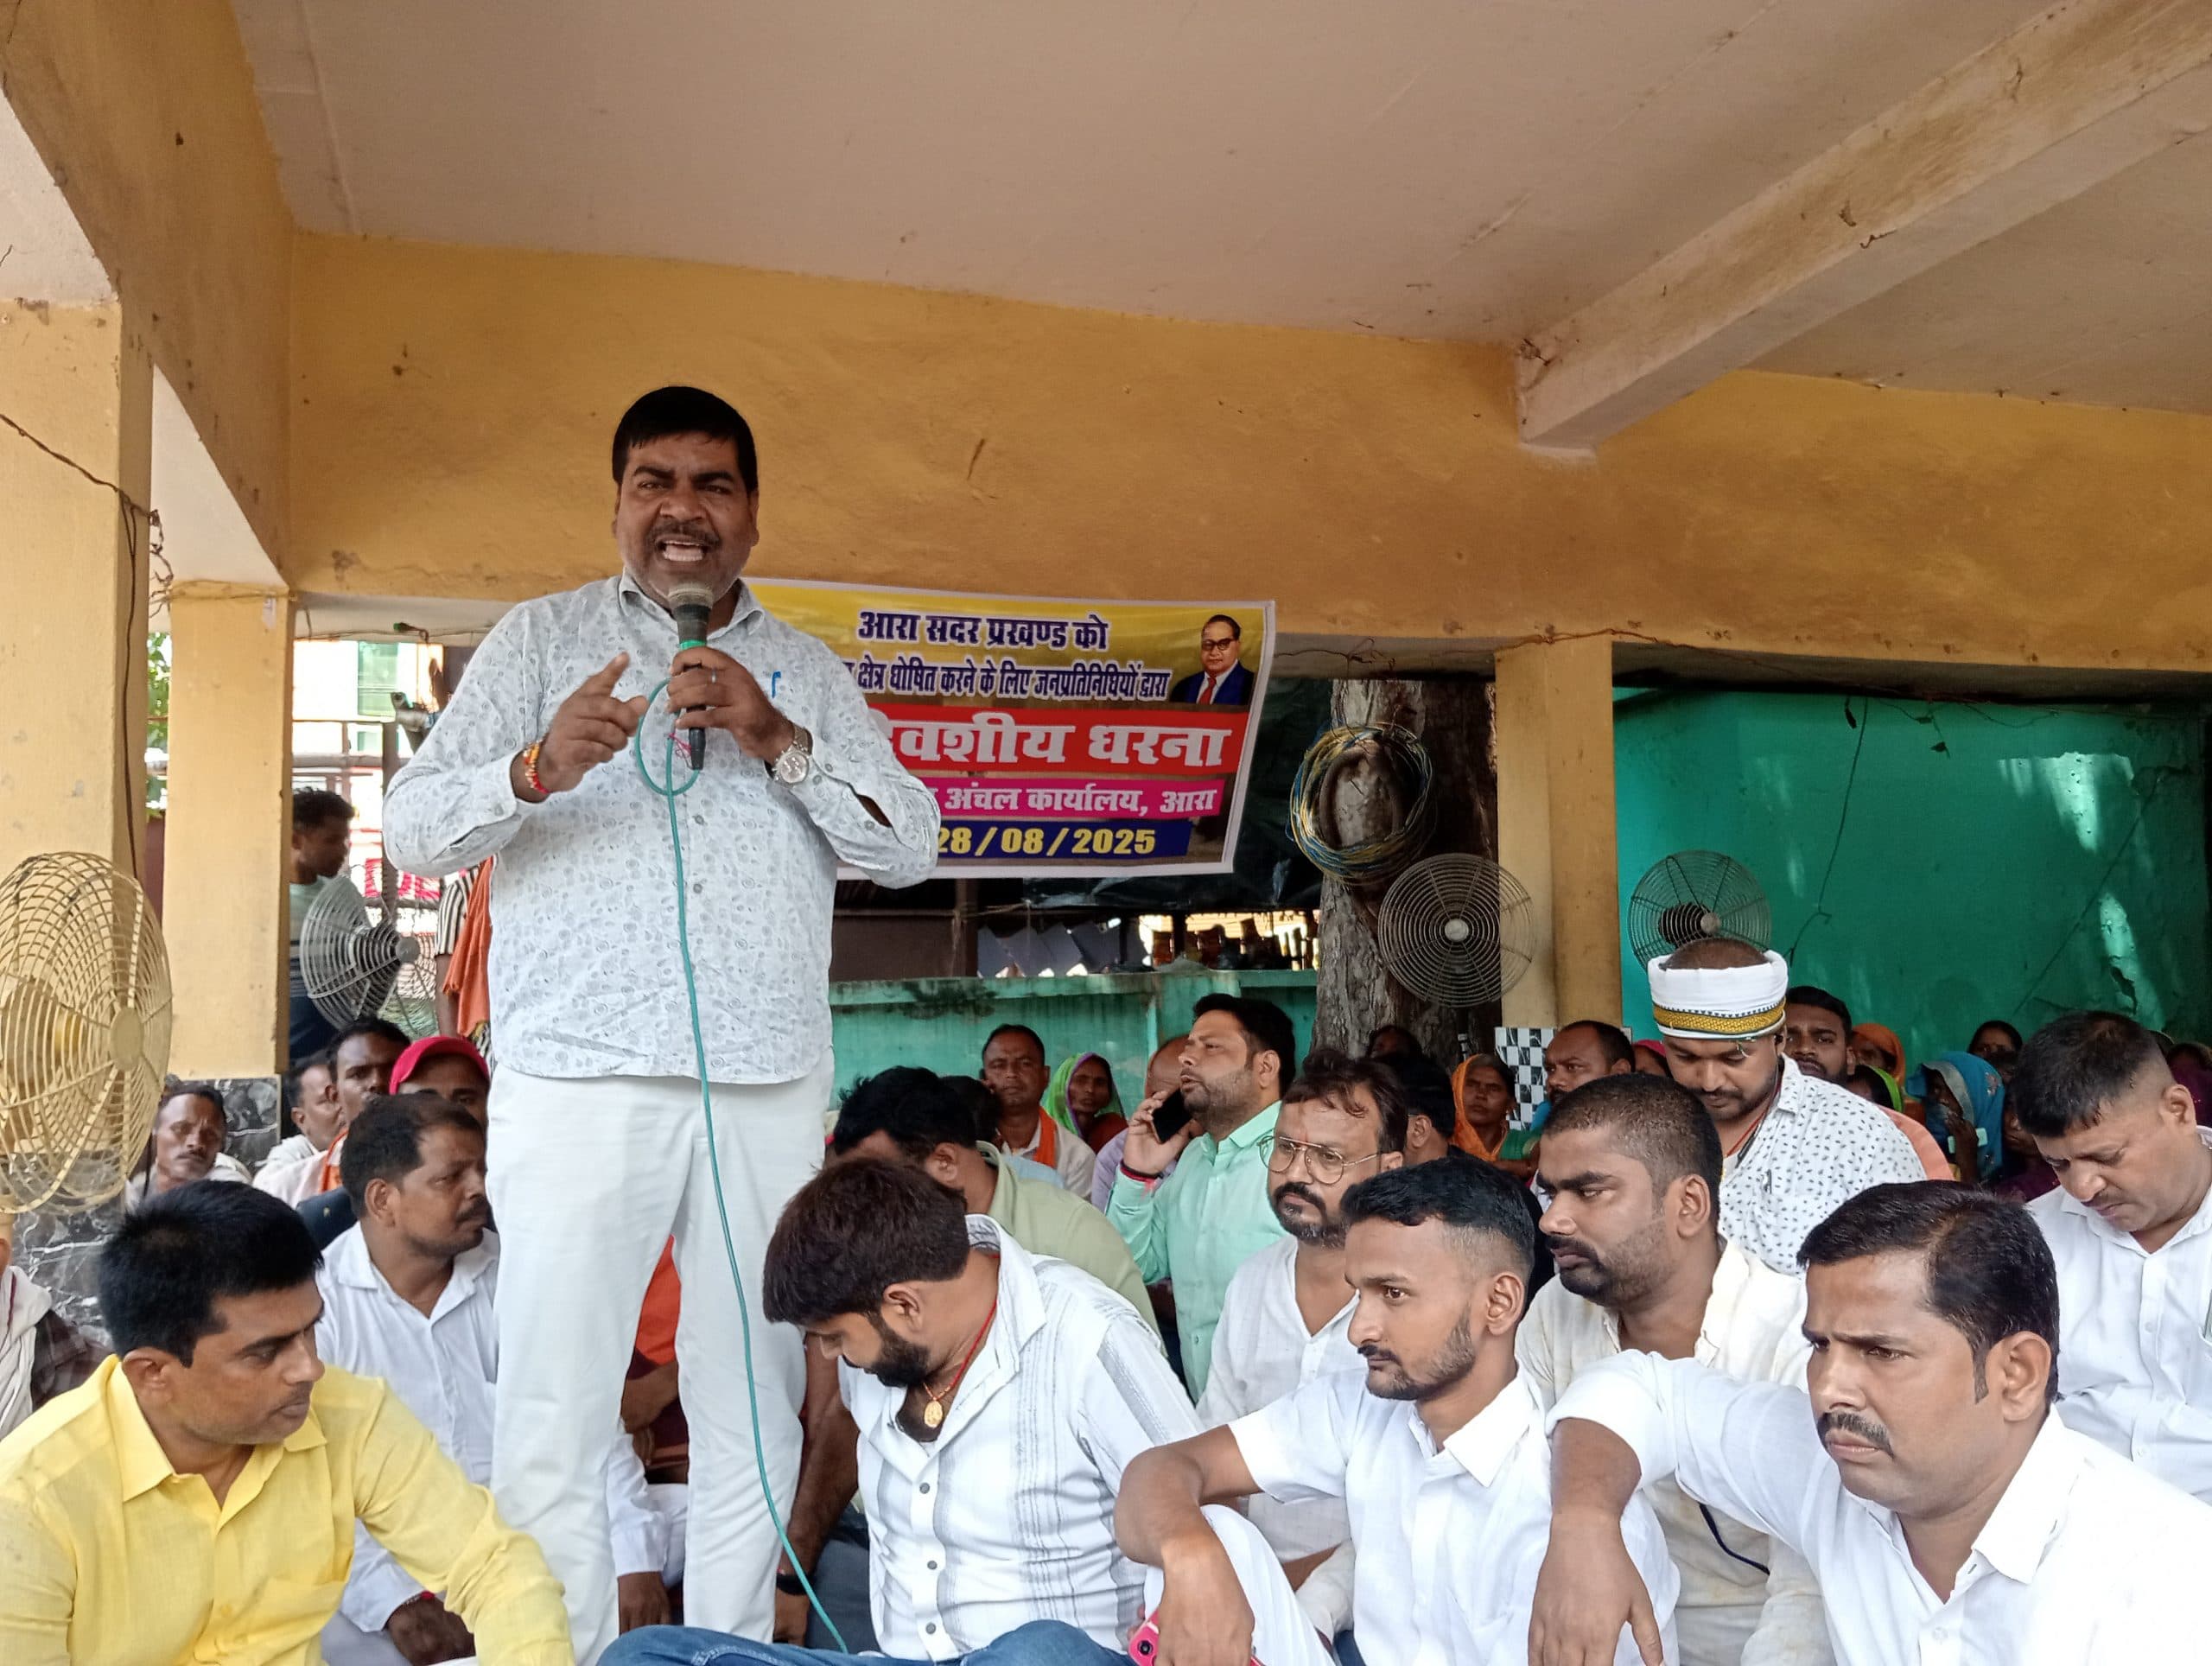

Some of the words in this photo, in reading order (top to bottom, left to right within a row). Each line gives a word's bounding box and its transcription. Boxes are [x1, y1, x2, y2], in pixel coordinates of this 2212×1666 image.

[858, 611, 921, 640] आरा
[925, 615, 982, 643] सदर
[987, 618, 1068, 646] प्रखण्ड
[1072, 614, 1109, 648] को
[858, 654, 887, 690] क्षेत्र
[890, 656, 938, 692] घोषित
[940, 658, 977, 694] करने
[980, 659, 997, 692] के
[1000, 660, 1033, 695] लिए
[1140, 671, 1171, 698] द्वारा
[869, 708, 1076, 763] वशीय
[1088, 725, 1233, 767] धरना
[944, 781, 1022, 810] अंचल
[1027, 783, 1148, 817] कार्यालय,
[1160, 789, 1217, 813] आरा
